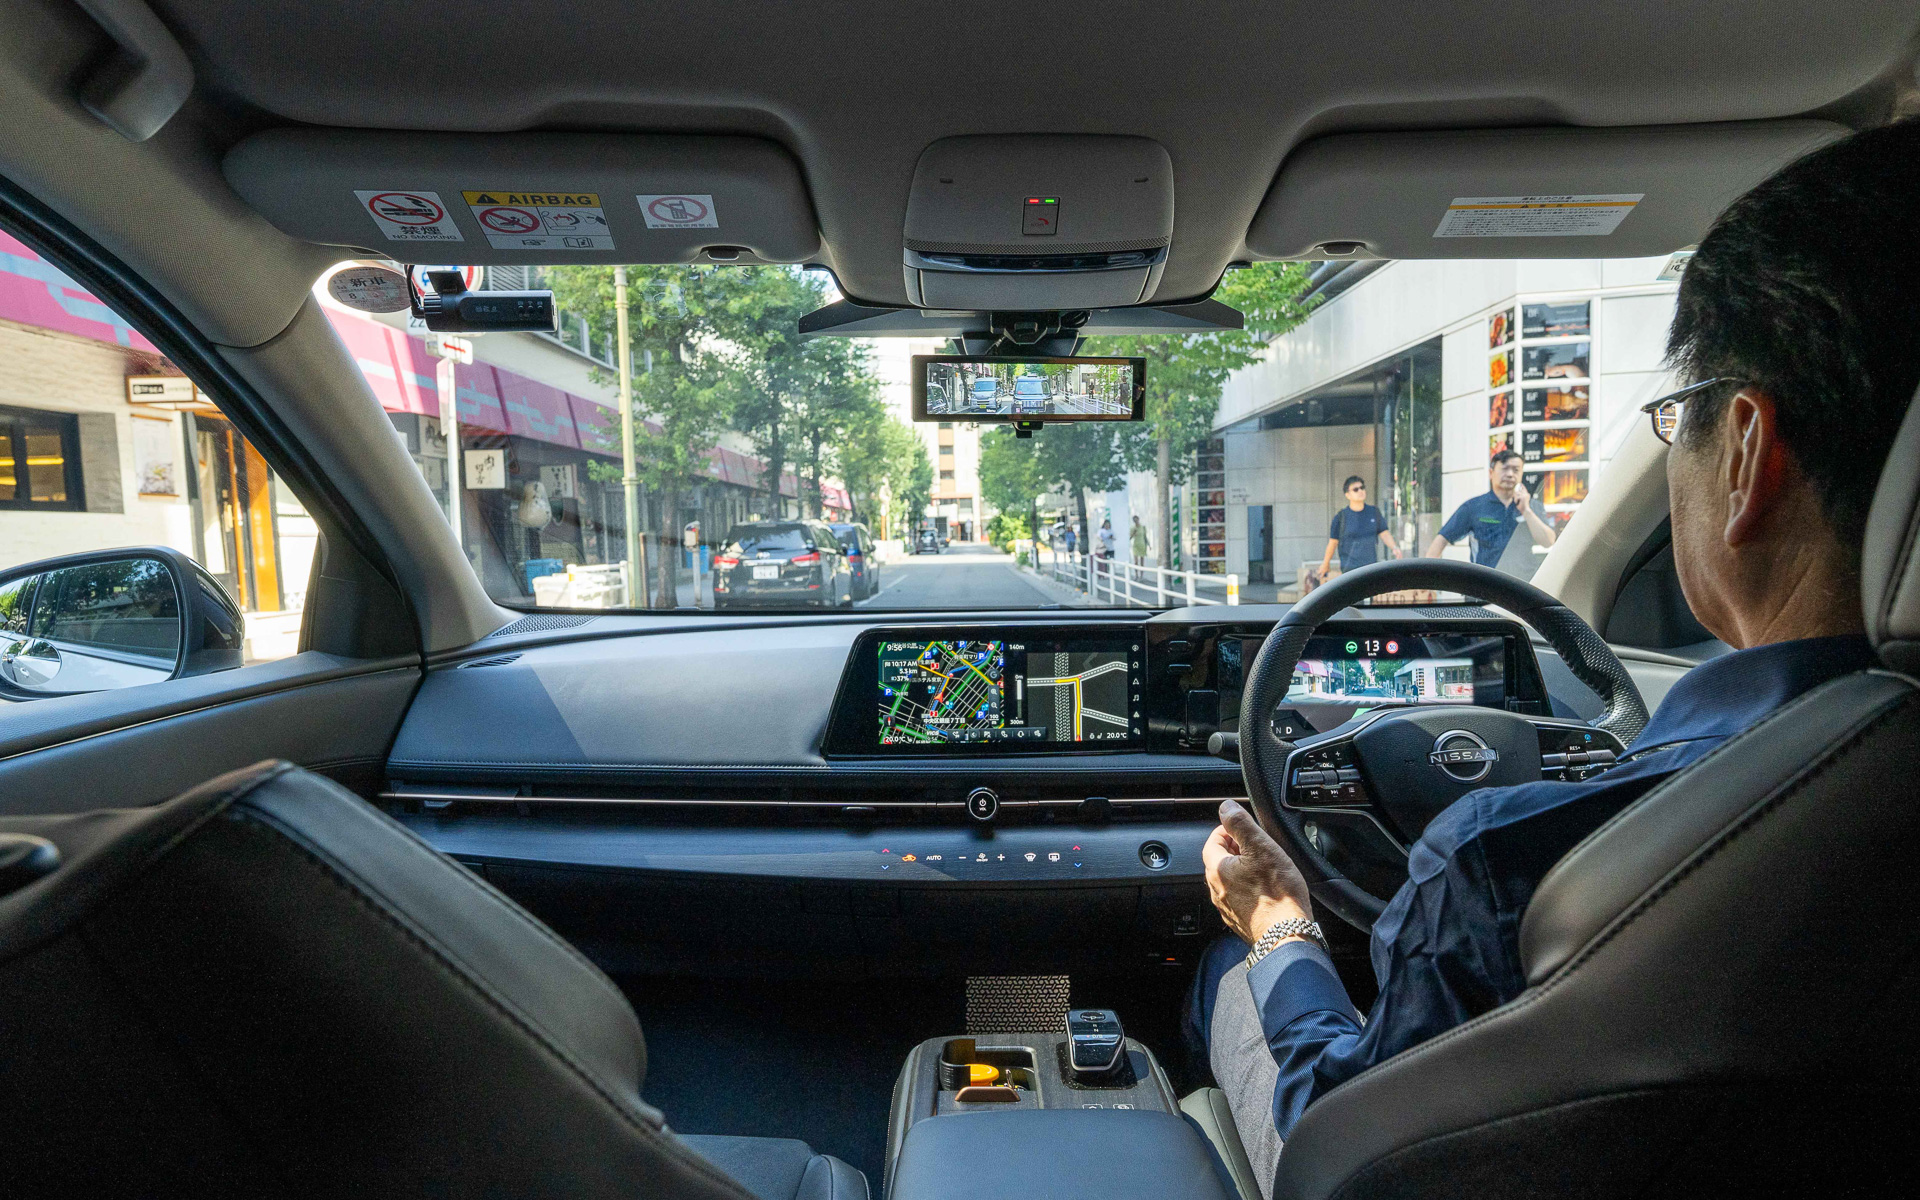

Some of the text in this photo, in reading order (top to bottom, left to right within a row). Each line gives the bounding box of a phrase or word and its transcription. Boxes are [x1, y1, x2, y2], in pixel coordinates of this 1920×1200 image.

[508, 194, 592, 205] AIRBAG
[887, 644, 903, 652] 9:56
[1364, 640, 1380, 652] 13
[1285, 726, 1293, 734] D
[1430, 751, 1496, 764] NISSAN
